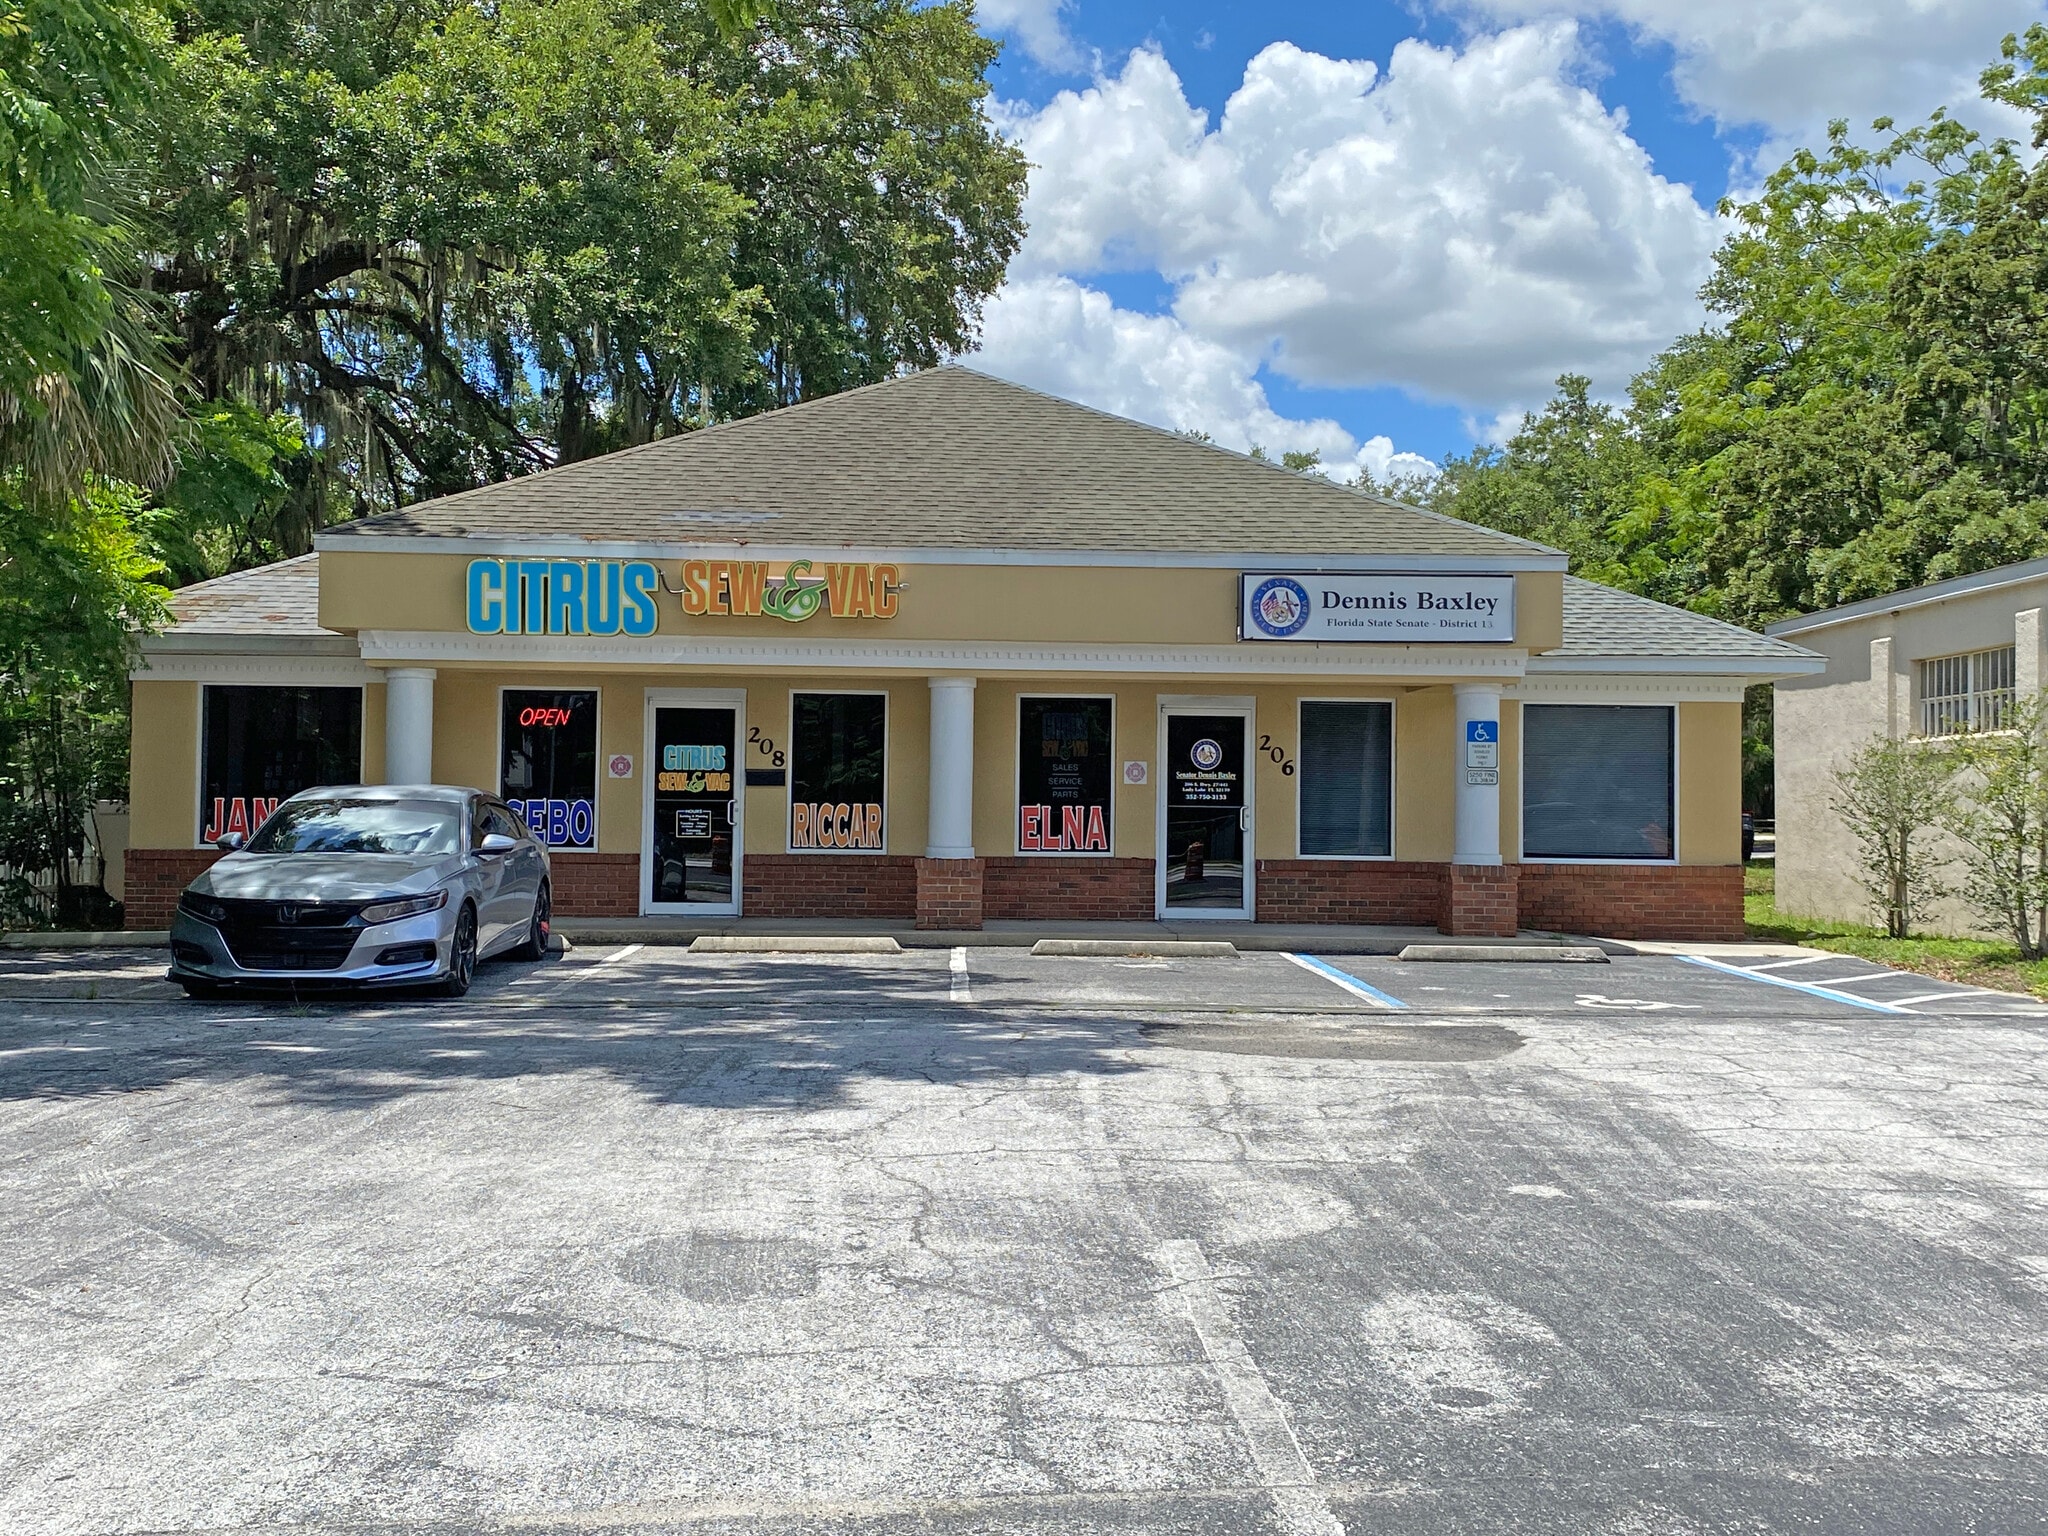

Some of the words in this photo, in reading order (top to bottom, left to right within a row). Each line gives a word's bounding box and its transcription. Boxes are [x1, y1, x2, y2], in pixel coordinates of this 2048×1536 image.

[466, 558, 659, 637] CITRUS
[682, 560, 768, 616] SEW
[762, 559, 828, 622] &
[824, 562, 900, 619] VAC
[1321, 590, 1407, 609] Dennis
[1416, 591, 1499, 616] Baxley
[1327, 618, 1364, 627] Florida
[1367, 618, 1393, 628] State
[1396, 618, 1430, 628] Senate
[1440, 619, 1478, 628] District
[519, 707, 571, 727] OPEN
[663, 745, 726, 771] CITRUS
[749, 727, 785, 767] 208
[1259, 735, 1294, 776] 206
[1052, 763, 1079, 771] SALES
[1176, 771, 1197, 779] Senator
[1198, 771, 1217, 779] Dennis
[1218, 771, 1237, 780] Baxley
[658, 772, 688, 791] SEW
[705, 773, 730, 791] VAC
[1048, 777, 1083, 785] SERVICE
[1052, 790, 1079, 798] PARTS
[792, 802, 881, 848] RICCAR
[1021, 803, 1107, 851] ELNA
